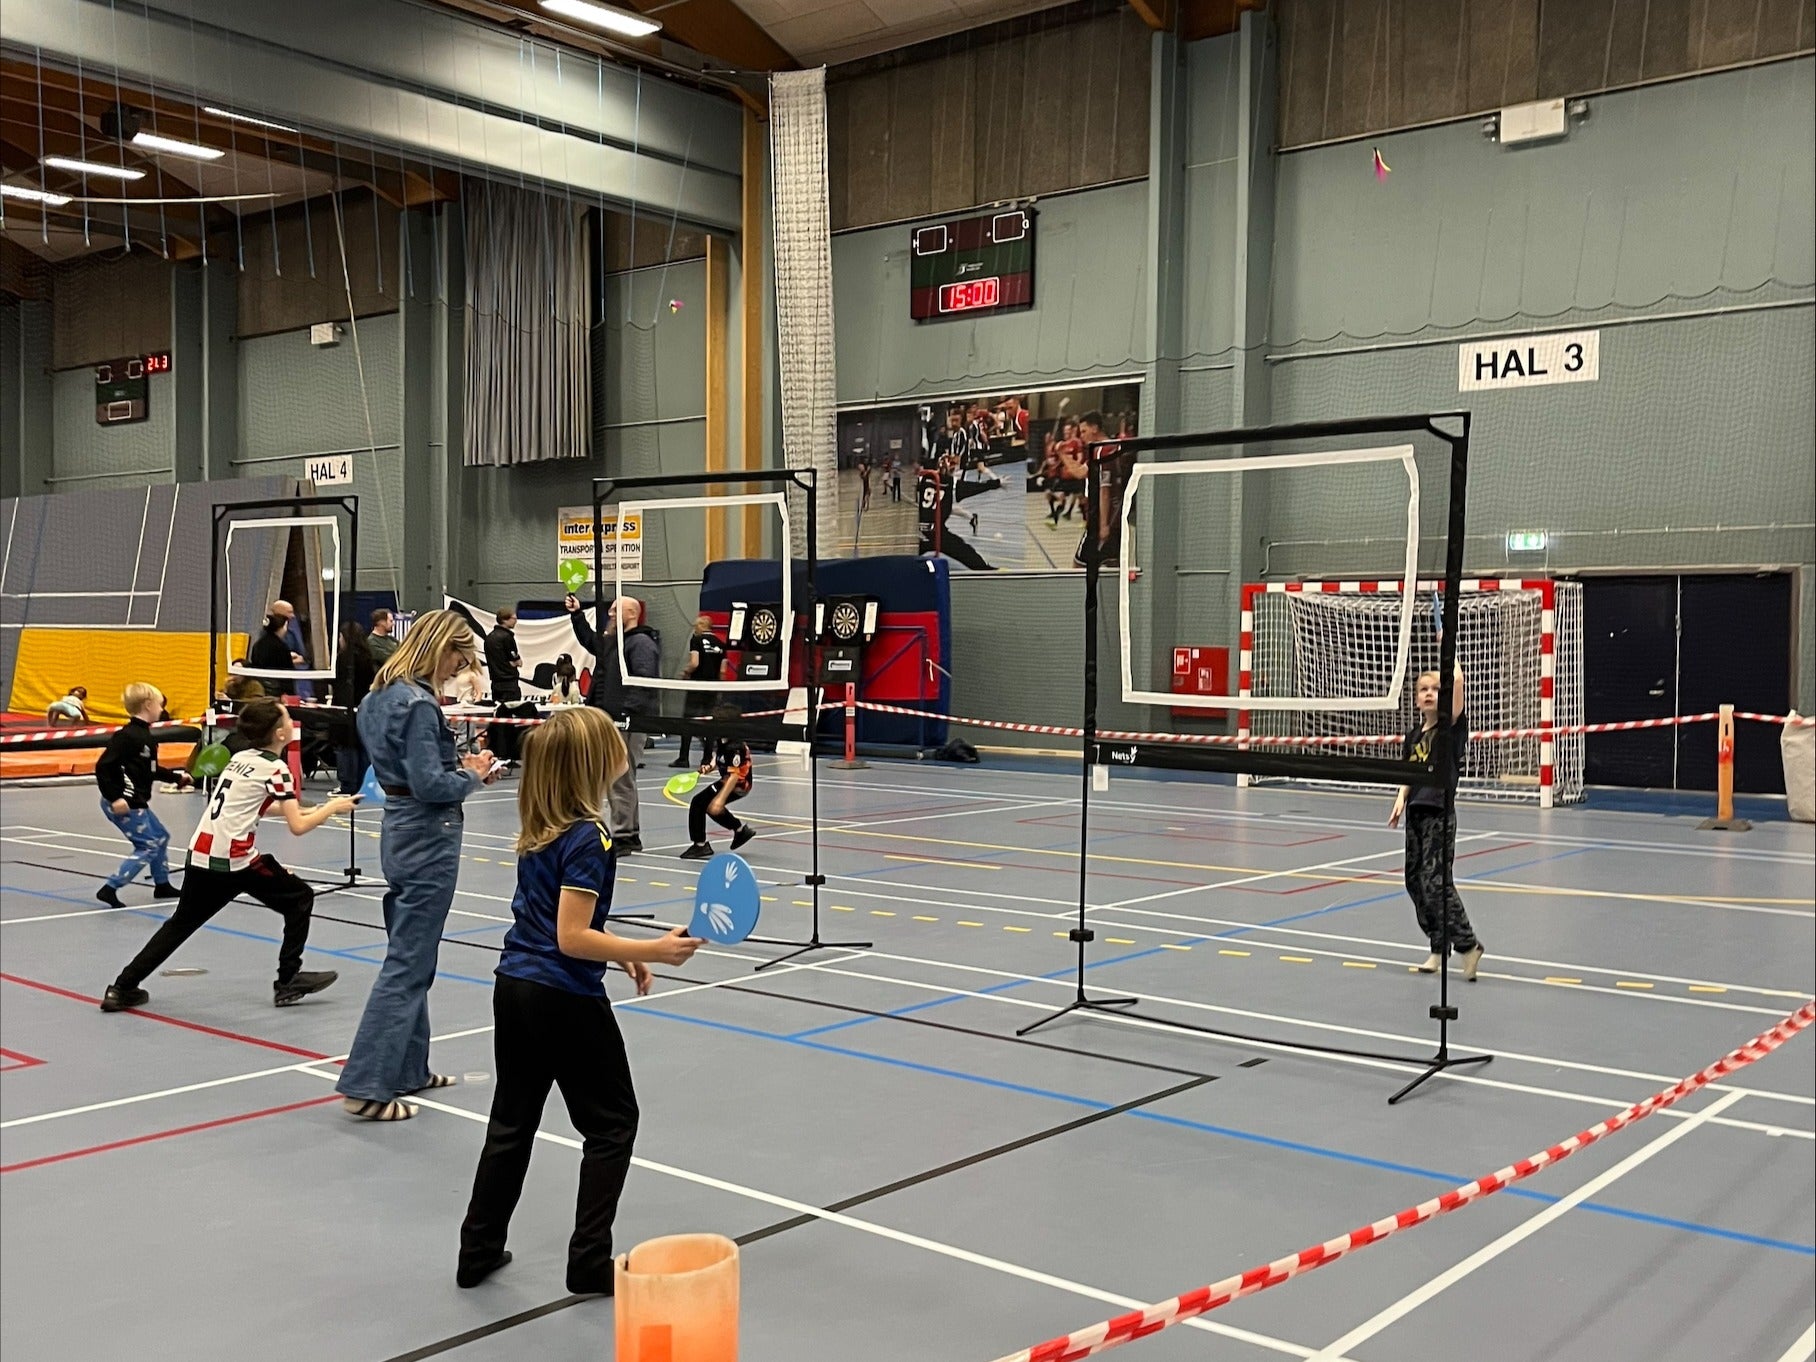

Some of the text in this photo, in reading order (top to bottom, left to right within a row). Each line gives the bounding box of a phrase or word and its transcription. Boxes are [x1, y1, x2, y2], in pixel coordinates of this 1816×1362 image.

[949, 280, 996, 308] 15:00
[1476, 343, 1584, 381] HAL 3
[310, 460, 347, 481] HAL 4
[564, 521, 590, 534] inter
[560, 544, 598, 554] TRANSPOR
[210, 778, 233, 820] 5
